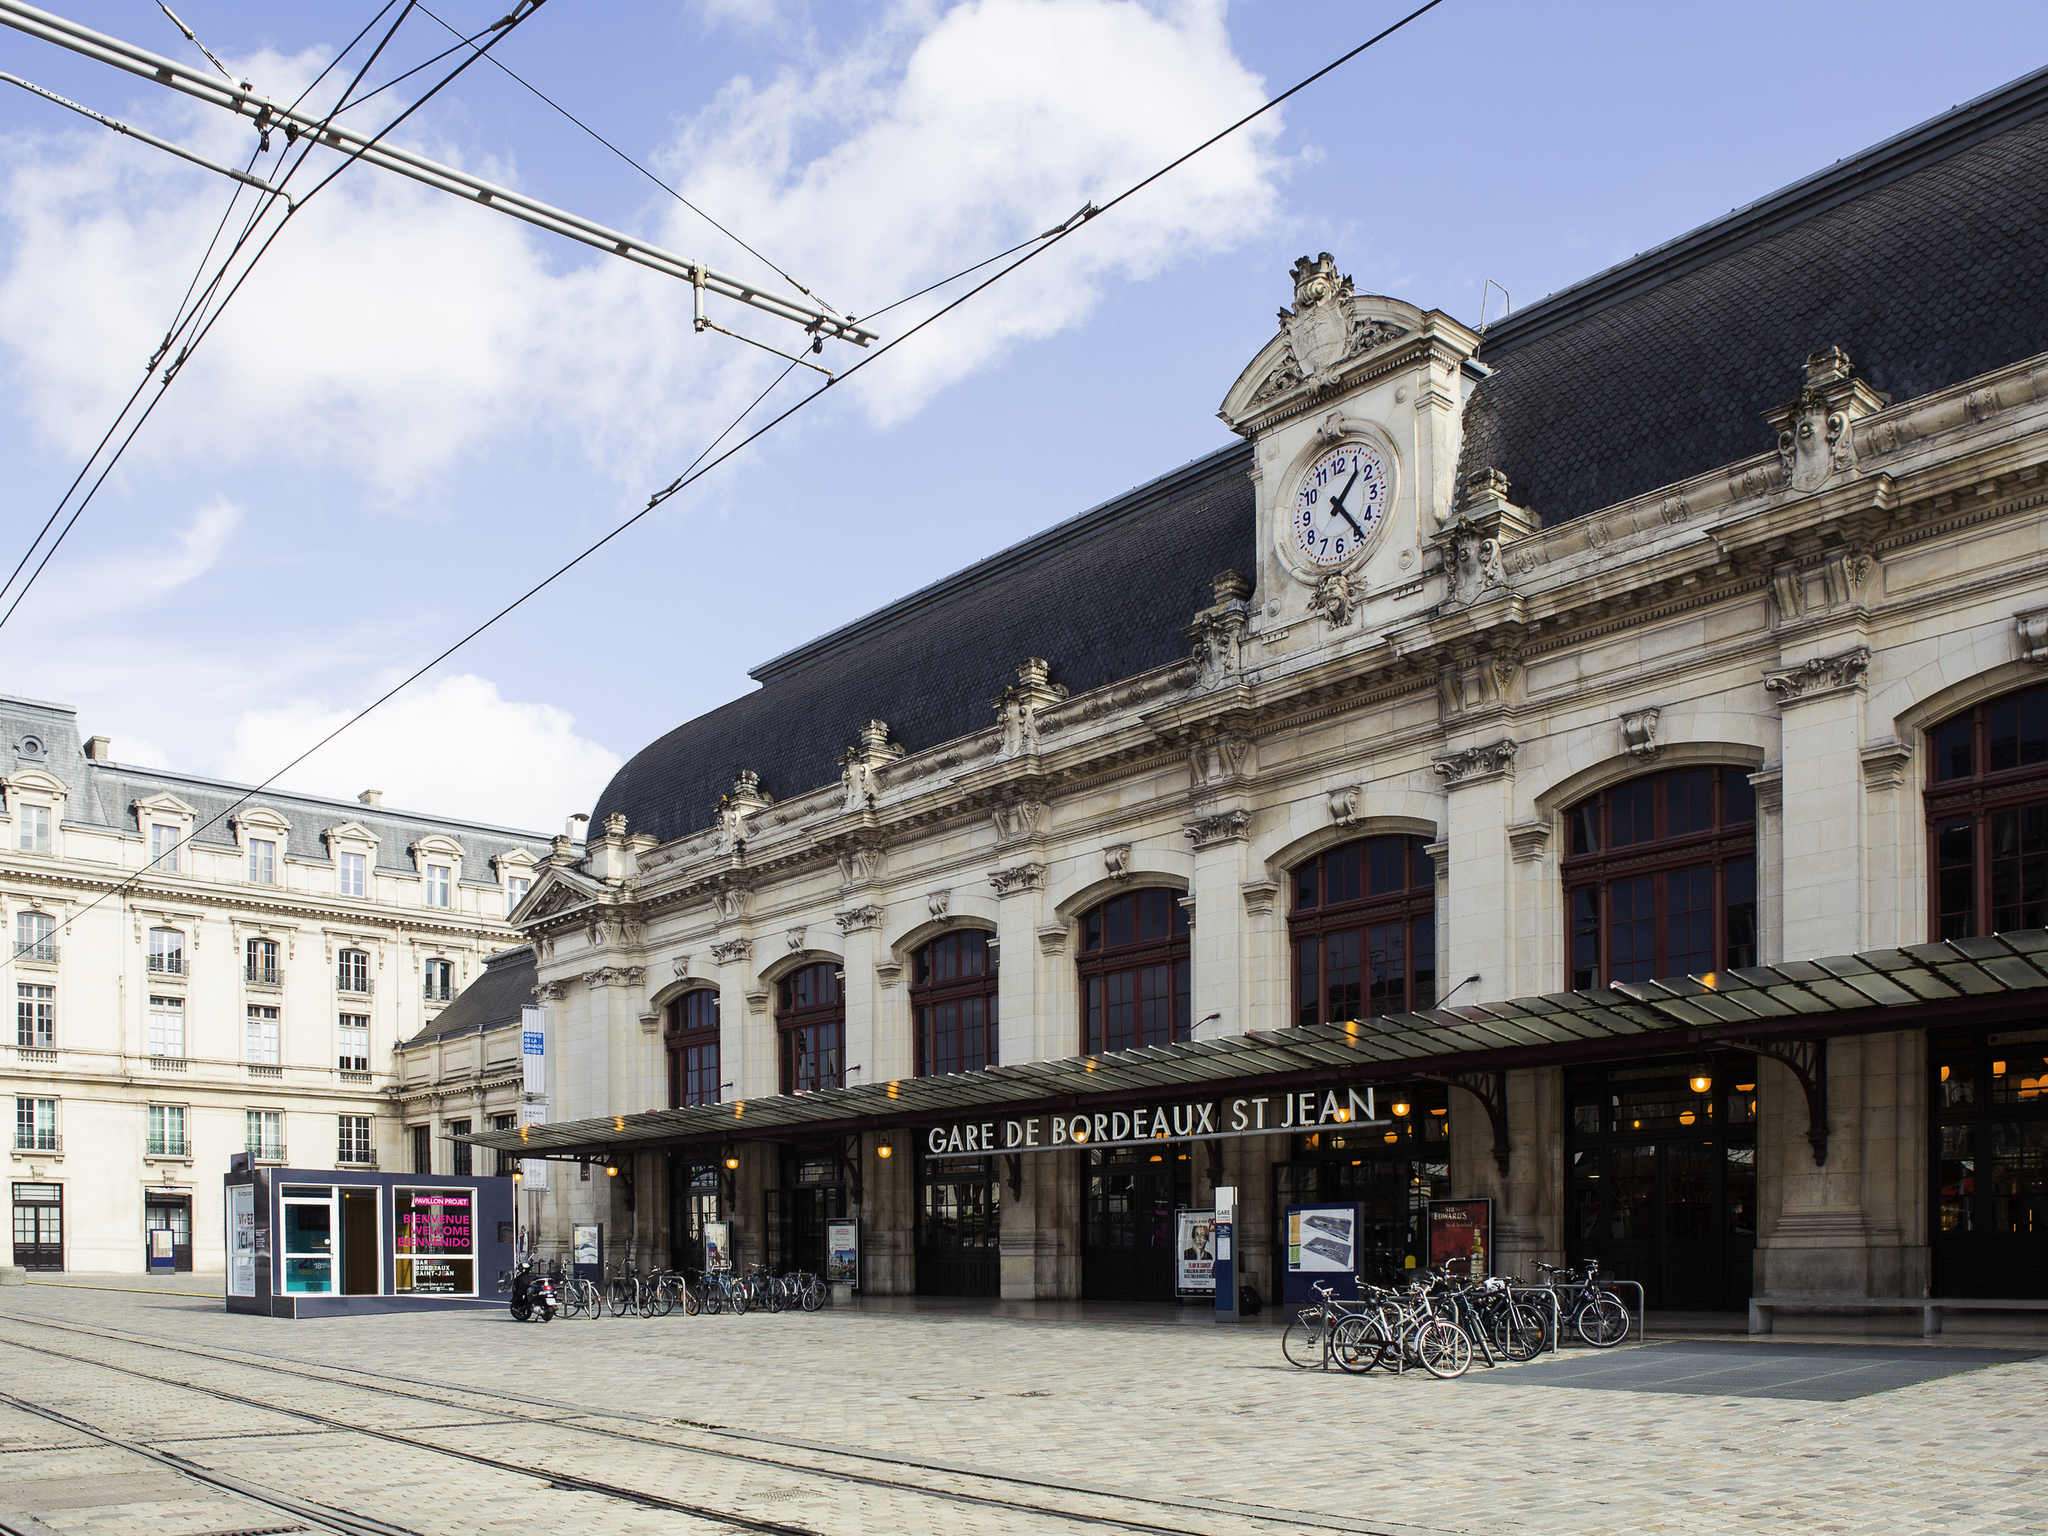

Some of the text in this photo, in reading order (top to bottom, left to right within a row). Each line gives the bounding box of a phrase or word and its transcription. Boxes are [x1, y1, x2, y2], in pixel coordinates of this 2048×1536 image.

[1331, 457, 1345, 475] 12
[1363, 463, 1373, 481] 2
[1316, 468, 1327, 486] 11
[1304, 489, 1317, 506] 10
[1369, 483, 1378, 500] 3
[1302, 511, 1311, 527] 9
[1364, 505, 1373, 521] 4
[1307, 530, 1315, 545] 8
[1320, 538, 1328, 556] 7
[1335, 538, 1344, 554] 6
[928, 1087, 1375, 1153] GARE DE BORDEAUX ST JEAN
[415, 1197, 467, 1206] PAVILLON PROJET
[404, 1215, 469, 1224] BIENVENUE
[411, 1226, 470, 1236] WELCOME
[398, 1238, 470, 1247] BIENVENIDO
